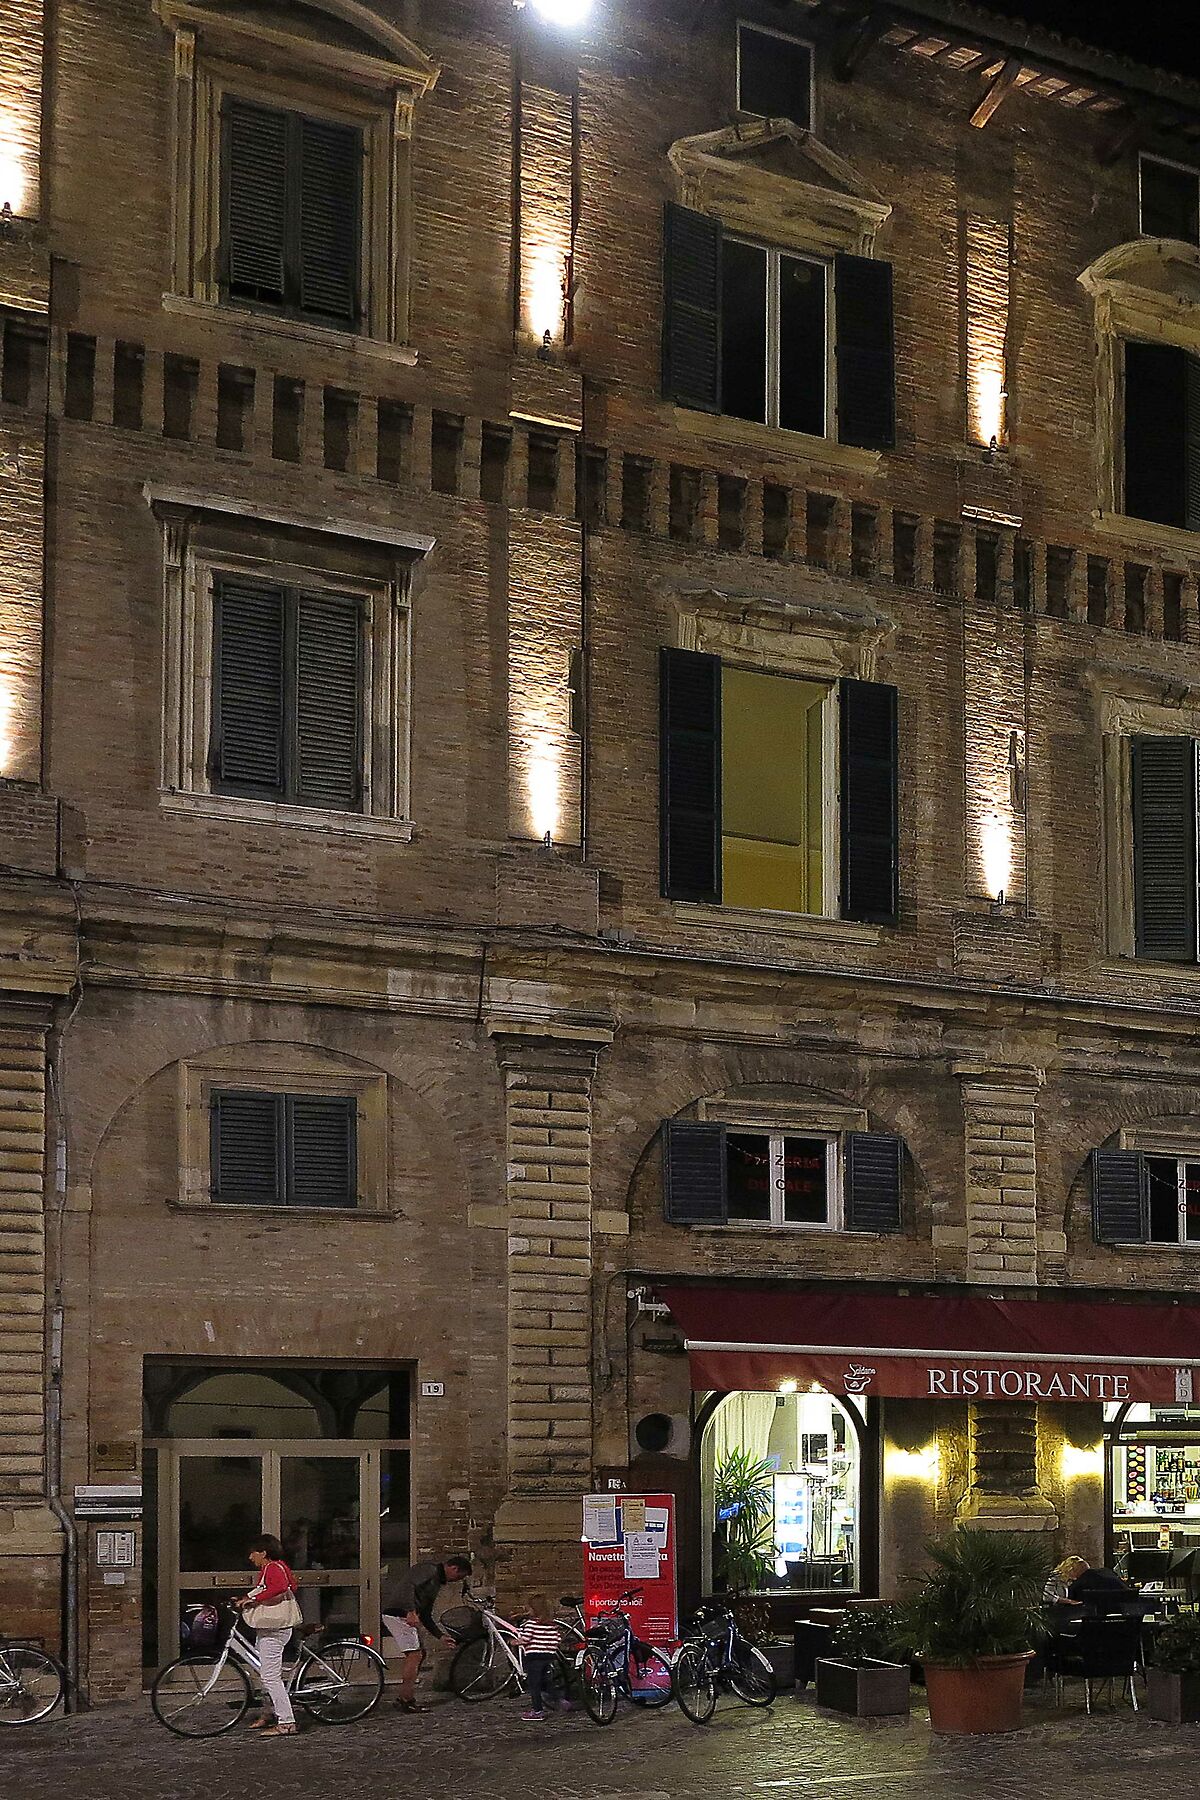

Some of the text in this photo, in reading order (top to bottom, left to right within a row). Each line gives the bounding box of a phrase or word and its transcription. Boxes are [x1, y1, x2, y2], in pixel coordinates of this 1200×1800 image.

[427, 1385, 440, 1393] 19
[927, 1369, 1130, 1399] RISTORANTE
[595, 1598, 628, 1608] portiao
